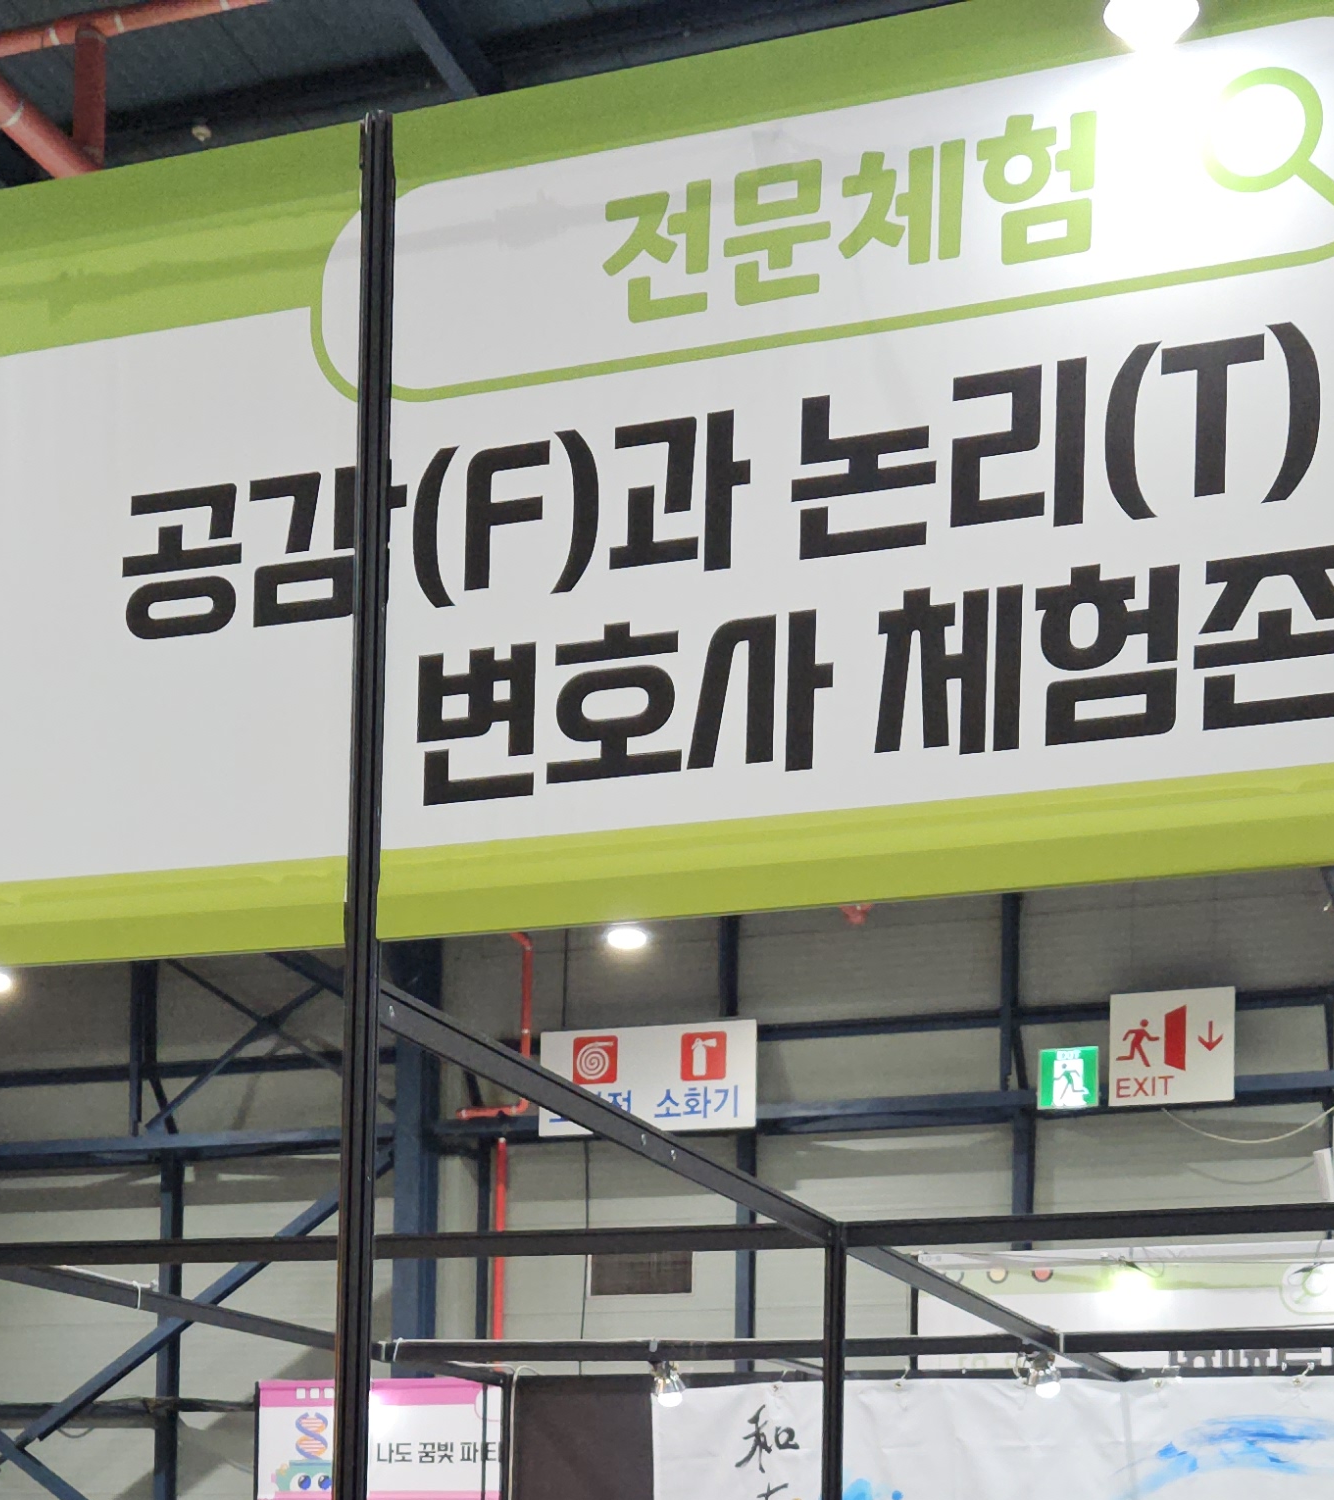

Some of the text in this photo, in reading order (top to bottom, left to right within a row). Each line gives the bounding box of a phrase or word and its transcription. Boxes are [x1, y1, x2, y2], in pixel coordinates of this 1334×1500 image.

[602, 110, 1098, 323] 전문체험
[122, 409, 750, 641] 공감(F)과
[792, 322, 1320, 560] 논리(T)
[417, 609, 833, 807] 변호사
[654, 1085, 739, 1119] 소화기
[1117, 1076, 1174, 1098] EXIT
[376, 1442, 412, 1463] 나도
[418, 1442, 453, 1464] 꿈빛
